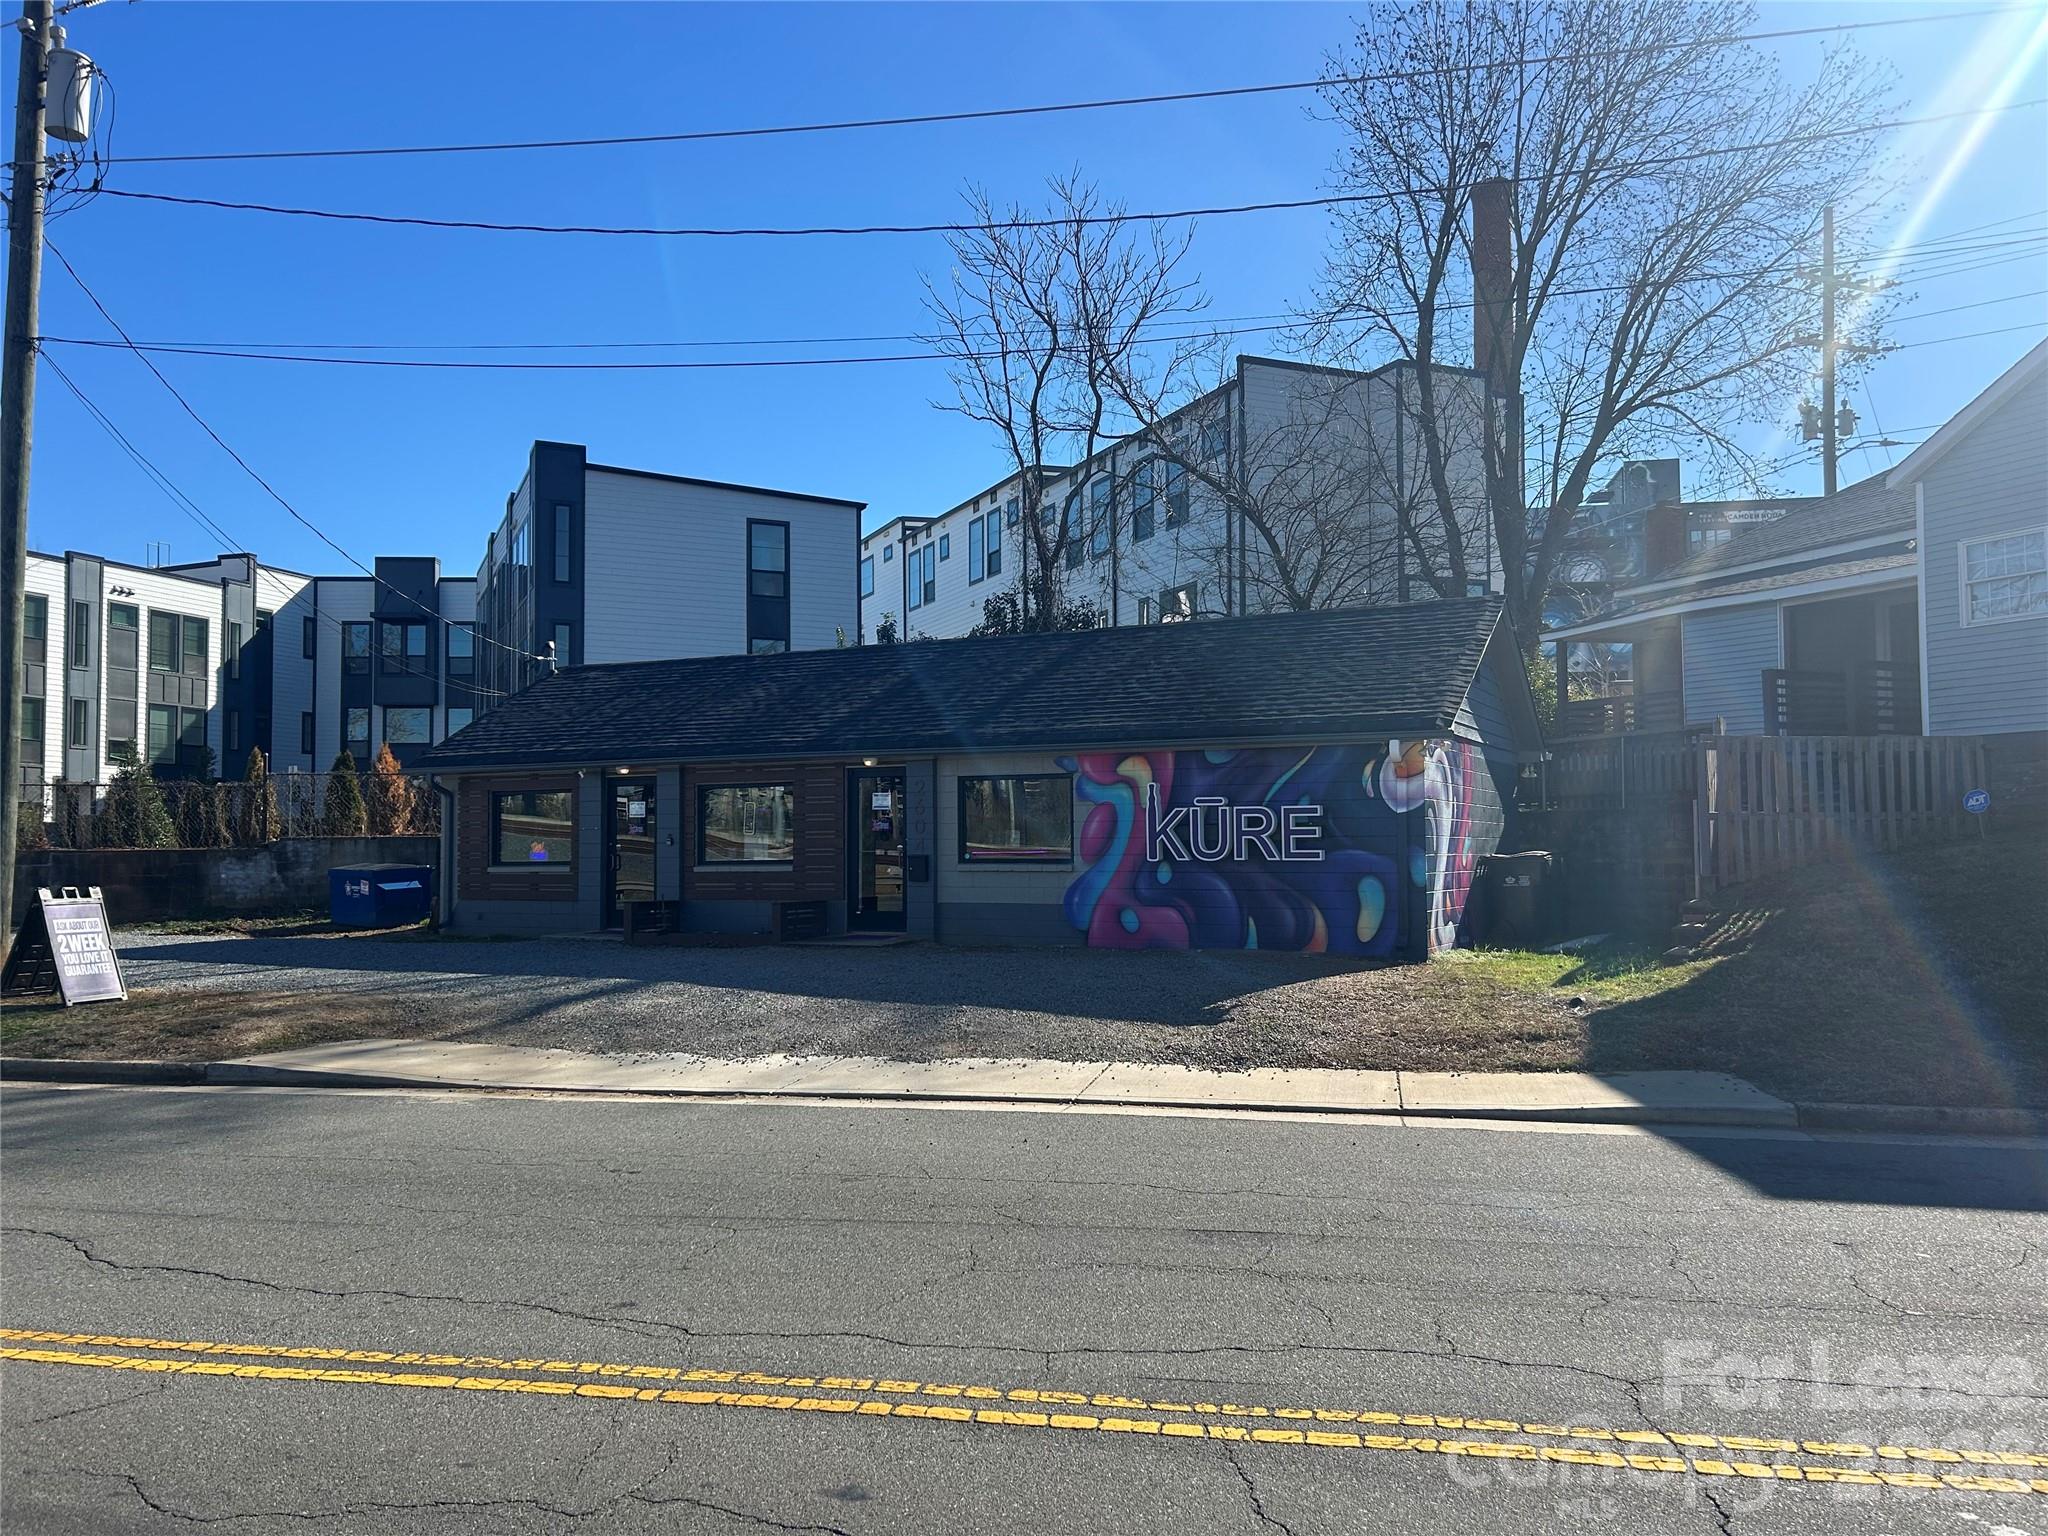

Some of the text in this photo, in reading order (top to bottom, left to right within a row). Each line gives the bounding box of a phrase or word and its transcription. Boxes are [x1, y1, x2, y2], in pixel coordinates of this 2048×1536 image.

[1967, 794, 1986, 807] ADT
[56, 920, 100, 931] ASK ABOUT OUR
[57, 933, 106, 953] 2 WEEK
[61, 951, 109, 965] YOU LOVE IT
[64, 963, 113, 977] GUARANTEE
